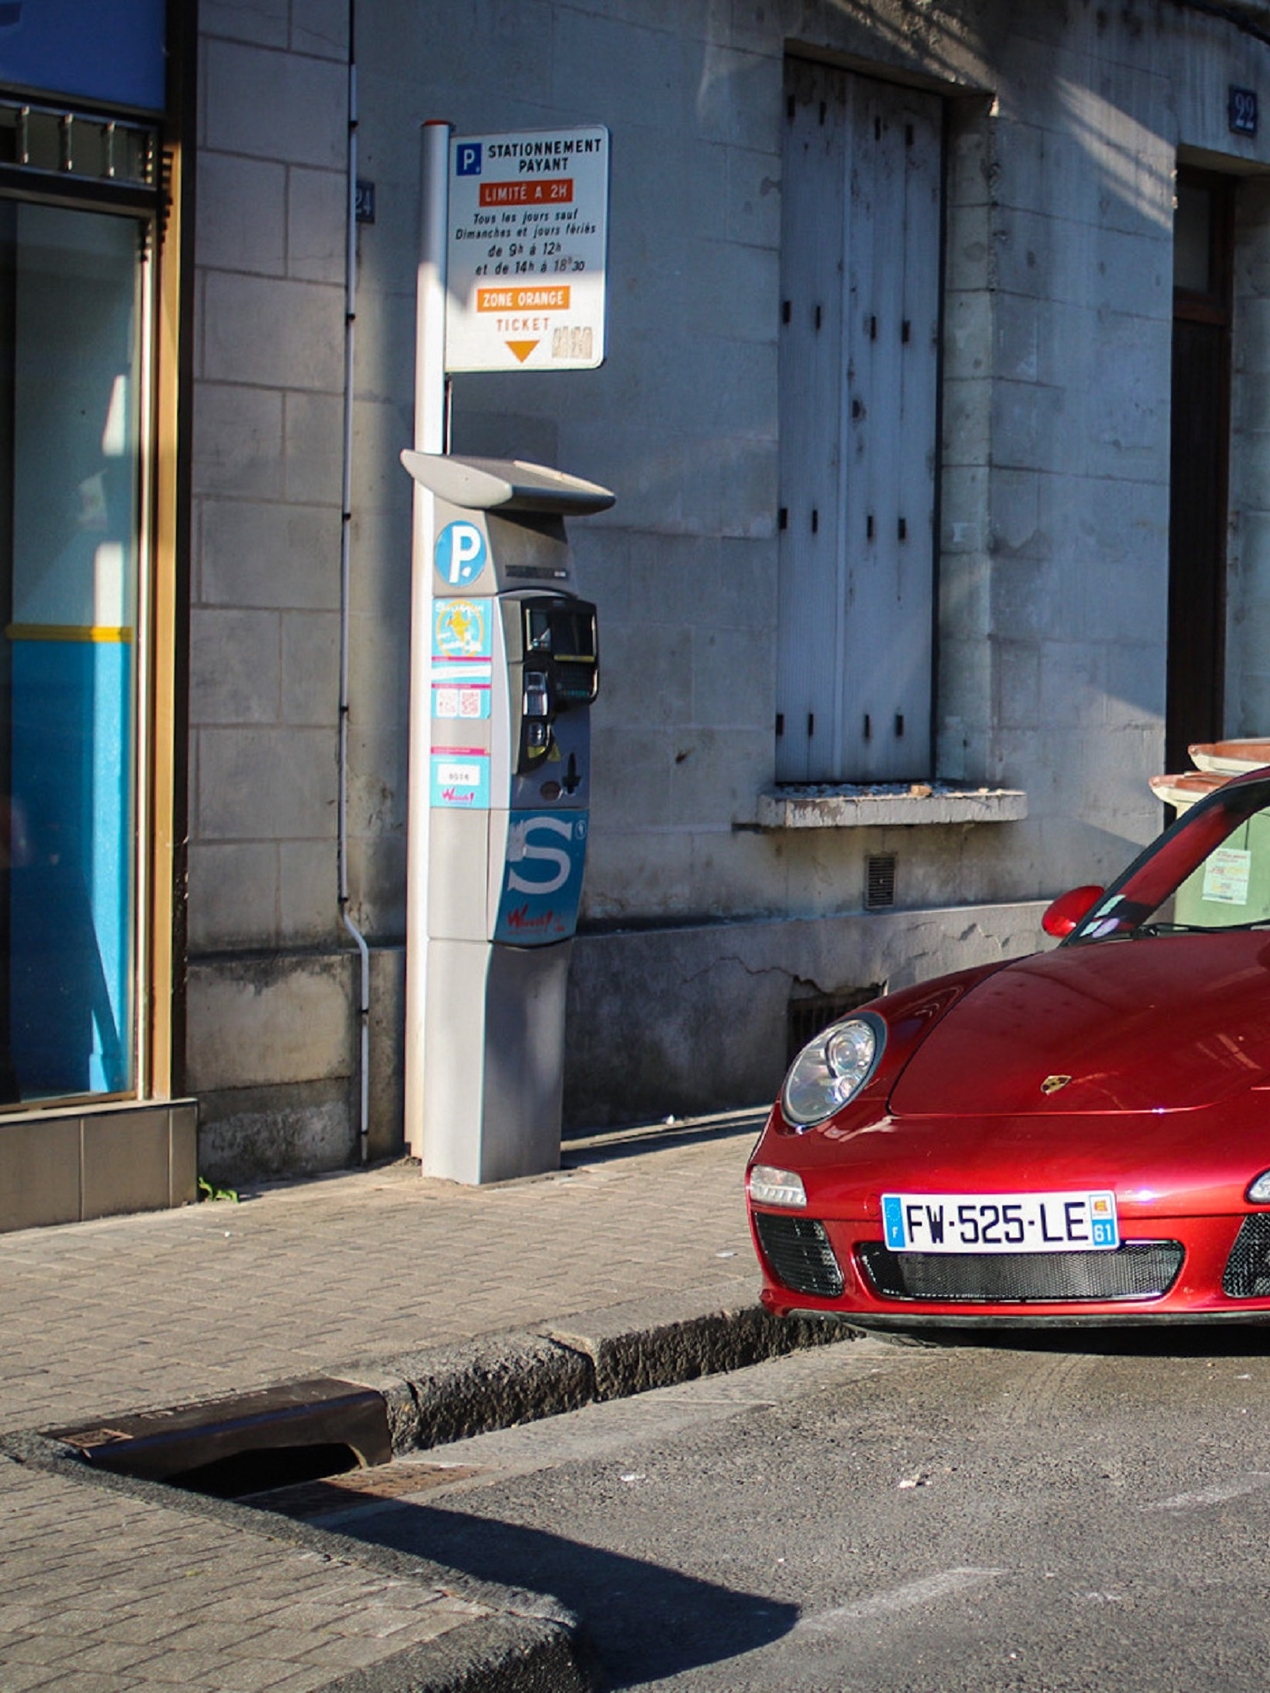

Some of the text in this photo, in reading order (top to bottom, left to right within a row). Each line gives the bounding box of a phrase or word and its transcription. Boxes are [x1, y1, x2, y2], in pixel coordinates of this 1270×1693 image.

[488, 139, 601, 158] STATIONNEMENT
[519, 157, 568, 173] PAYANT
[485, 184, 527, 202] LIMITÉ
[551, 184, 568, 198] 2H
[473, 208, 578, 224] Tous les jours sauf
[455, 227, 511, 240] Dimanches
[516, 226, 527, 237] et
[533, 224, 560, 239] jours
[488, 245, 502, 258] de
[509, 243, 524, 256] 9h
[543, 242, 562, 255] 12h
[475, 263, 487, 276] et
[495, 262, 508, 275] de
[515, 261, 534, 273] 14h
[483, 290, 564, 307] ZONE ORANGE
[496, 317, 550, 331] TICKET
[906, 1202, 1089, 1244] FW-525-LE
[892, 1226, 898, 1239] F
[1094, 1224, 1113, 1242] 61
